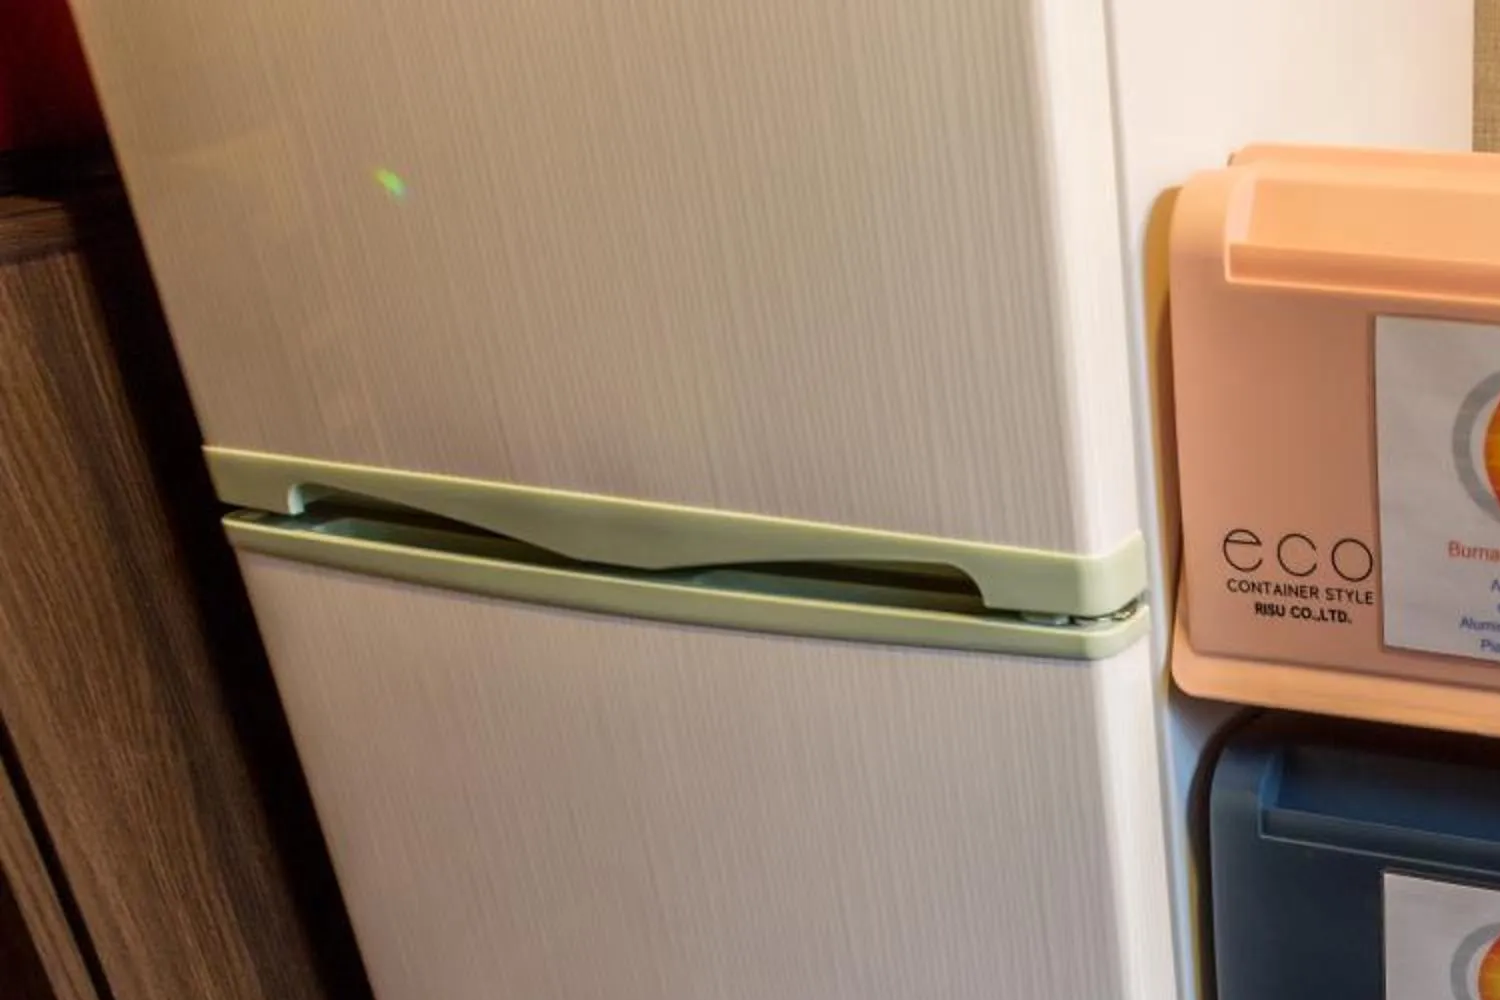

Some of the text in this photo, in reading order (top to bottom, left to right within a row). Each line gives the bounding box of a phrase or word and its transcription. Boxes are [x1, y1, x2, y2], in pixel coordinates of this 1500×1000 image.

[1223, 529, 1373, 582] eco
[1227, 578, 1375, 605] CONTAINER STYLE
[1255, 601, 1286, 617] RISU
